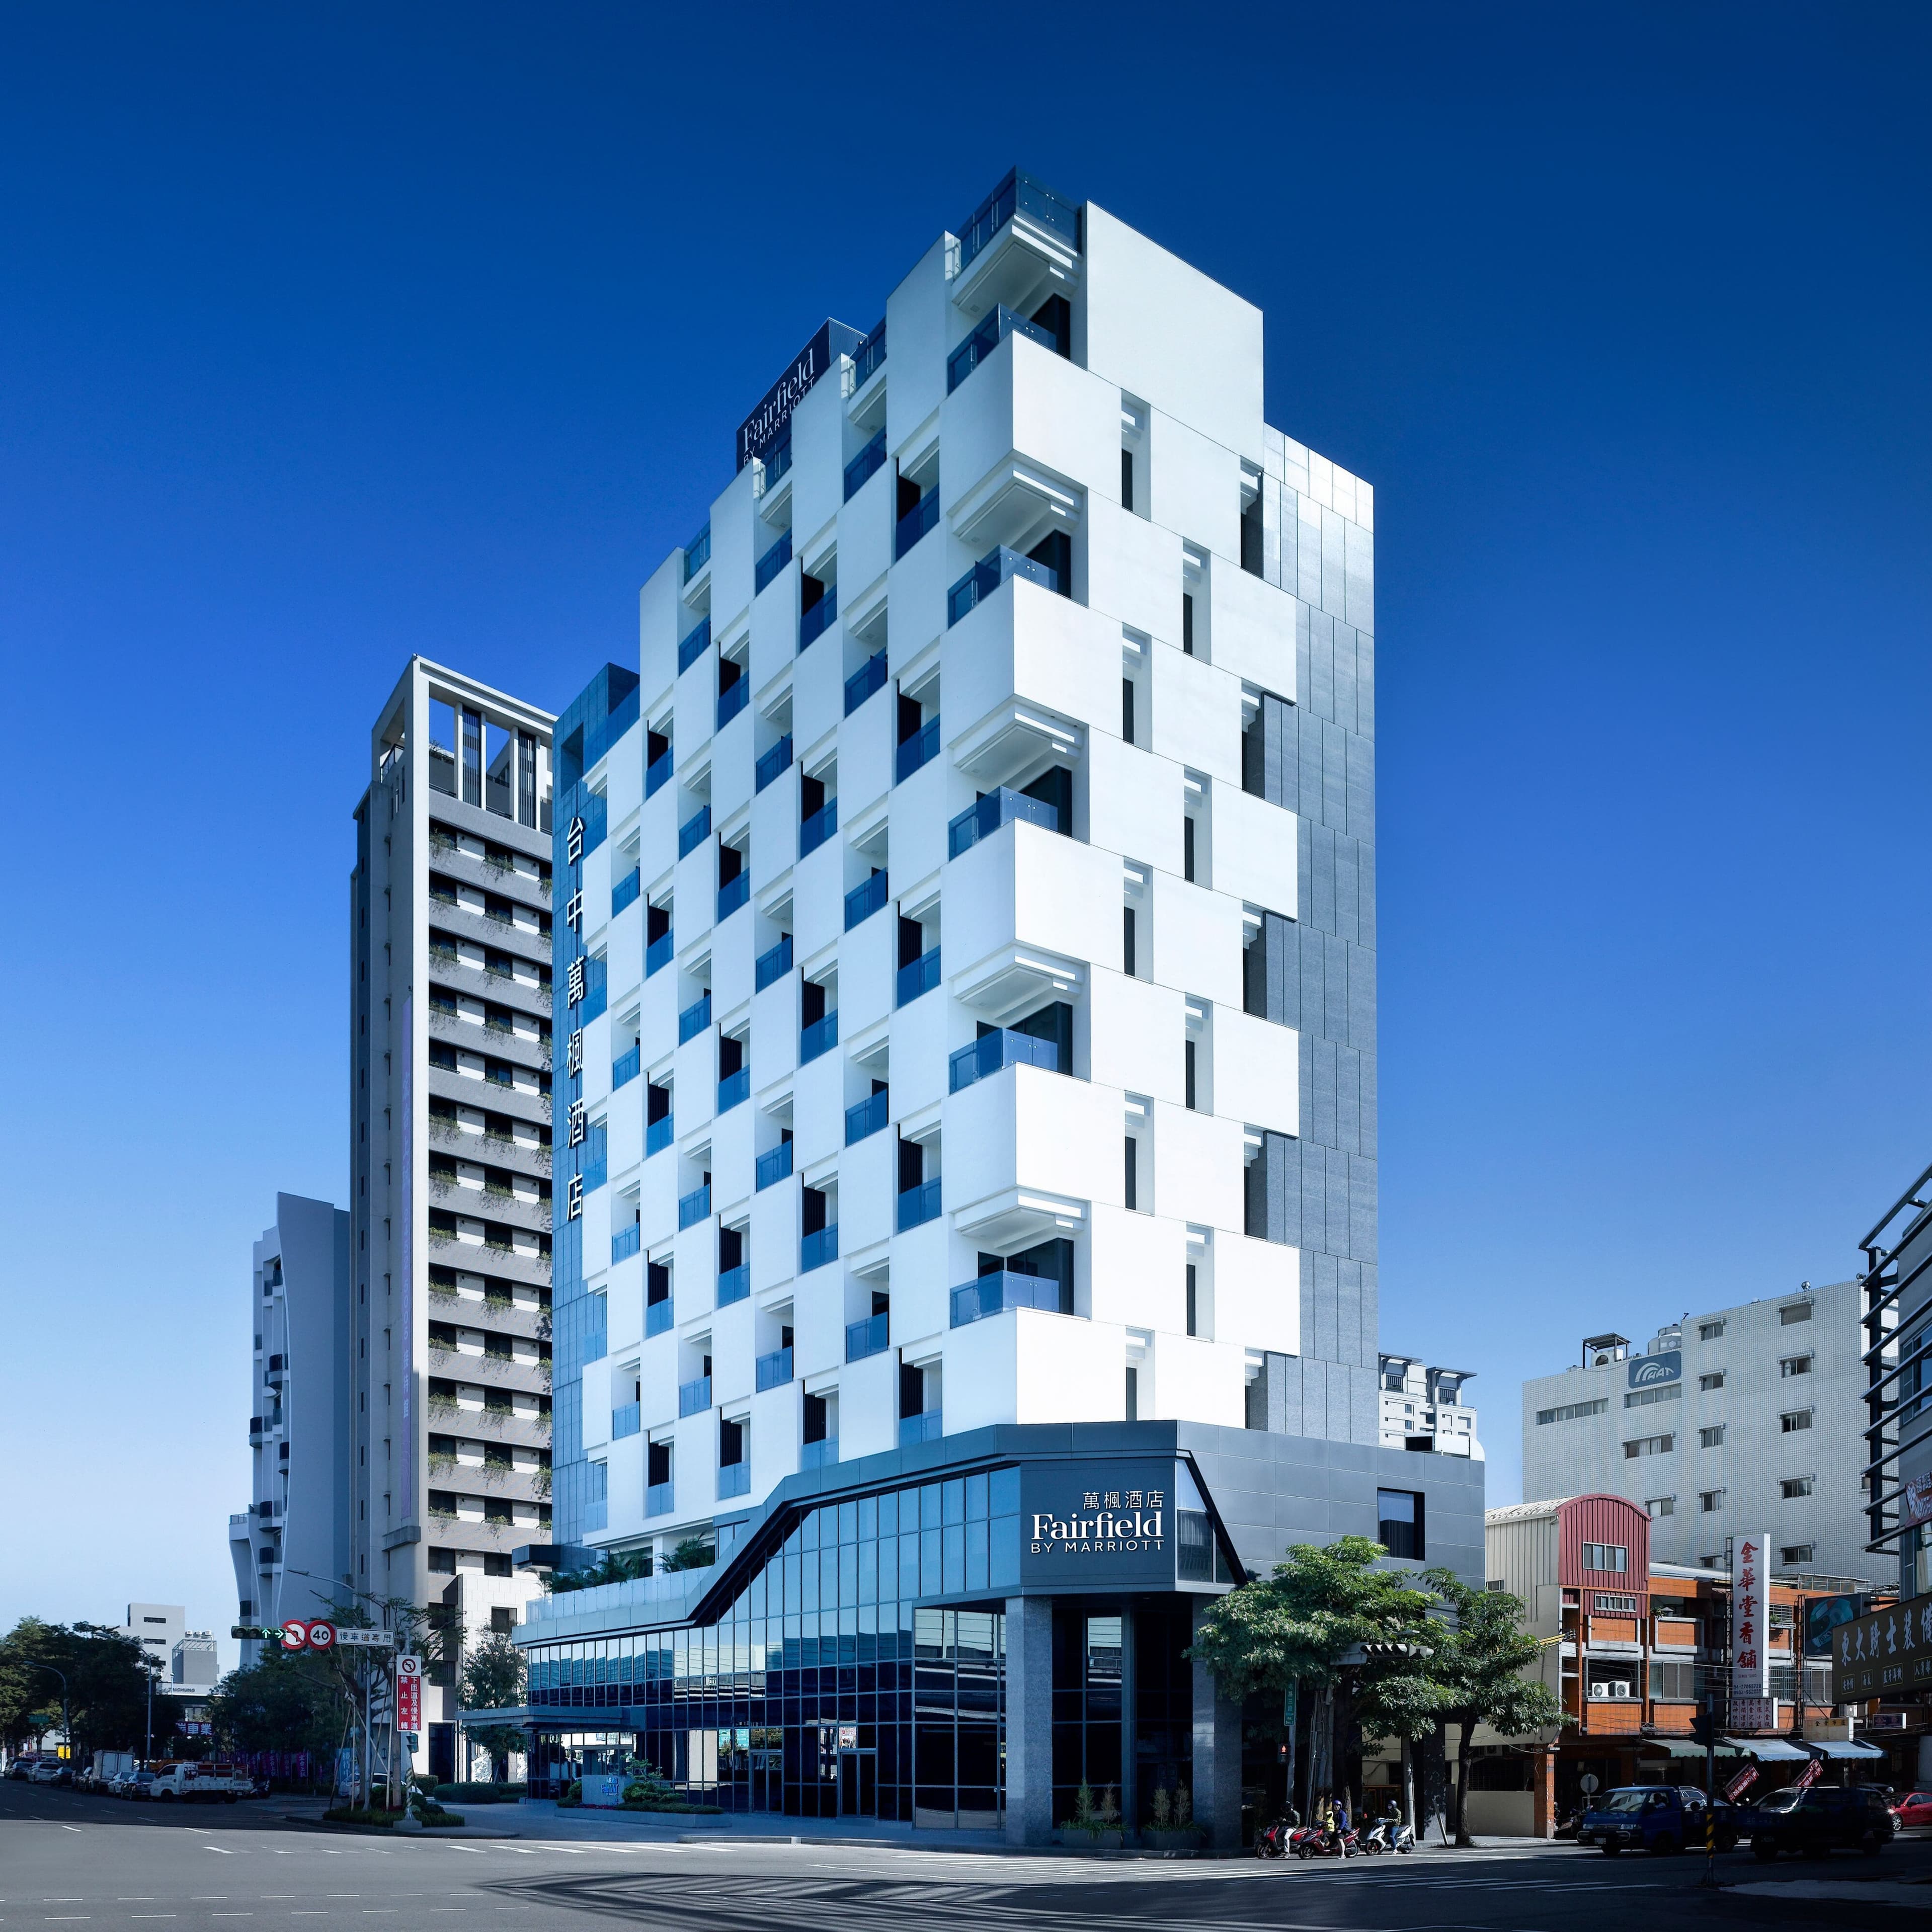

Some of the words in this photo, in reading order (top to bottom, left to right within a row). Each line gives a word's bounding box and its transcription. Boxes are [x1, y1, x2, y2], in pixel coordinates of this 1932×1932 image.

[744, 348, 815, 453] Fairfield
[759, 376, 815, 449] MARRIOTT
[567, 817, 584, 1222] 台中萬楓酒店
[1082, 1490, 1164, 1510] 萬楓酒店
[1031, 1511, 1164, 1540] Fairfield
[1031, 1542, 1054, 1554] BY
[1065, 1540, 1164, 1553] MARRIOTT
[313, 1630, 329, 1640] 40
[340, 1633, 391, 1643] 慢車道專用
[411, 1676, 419, 1730] 下匝道及慢車道
